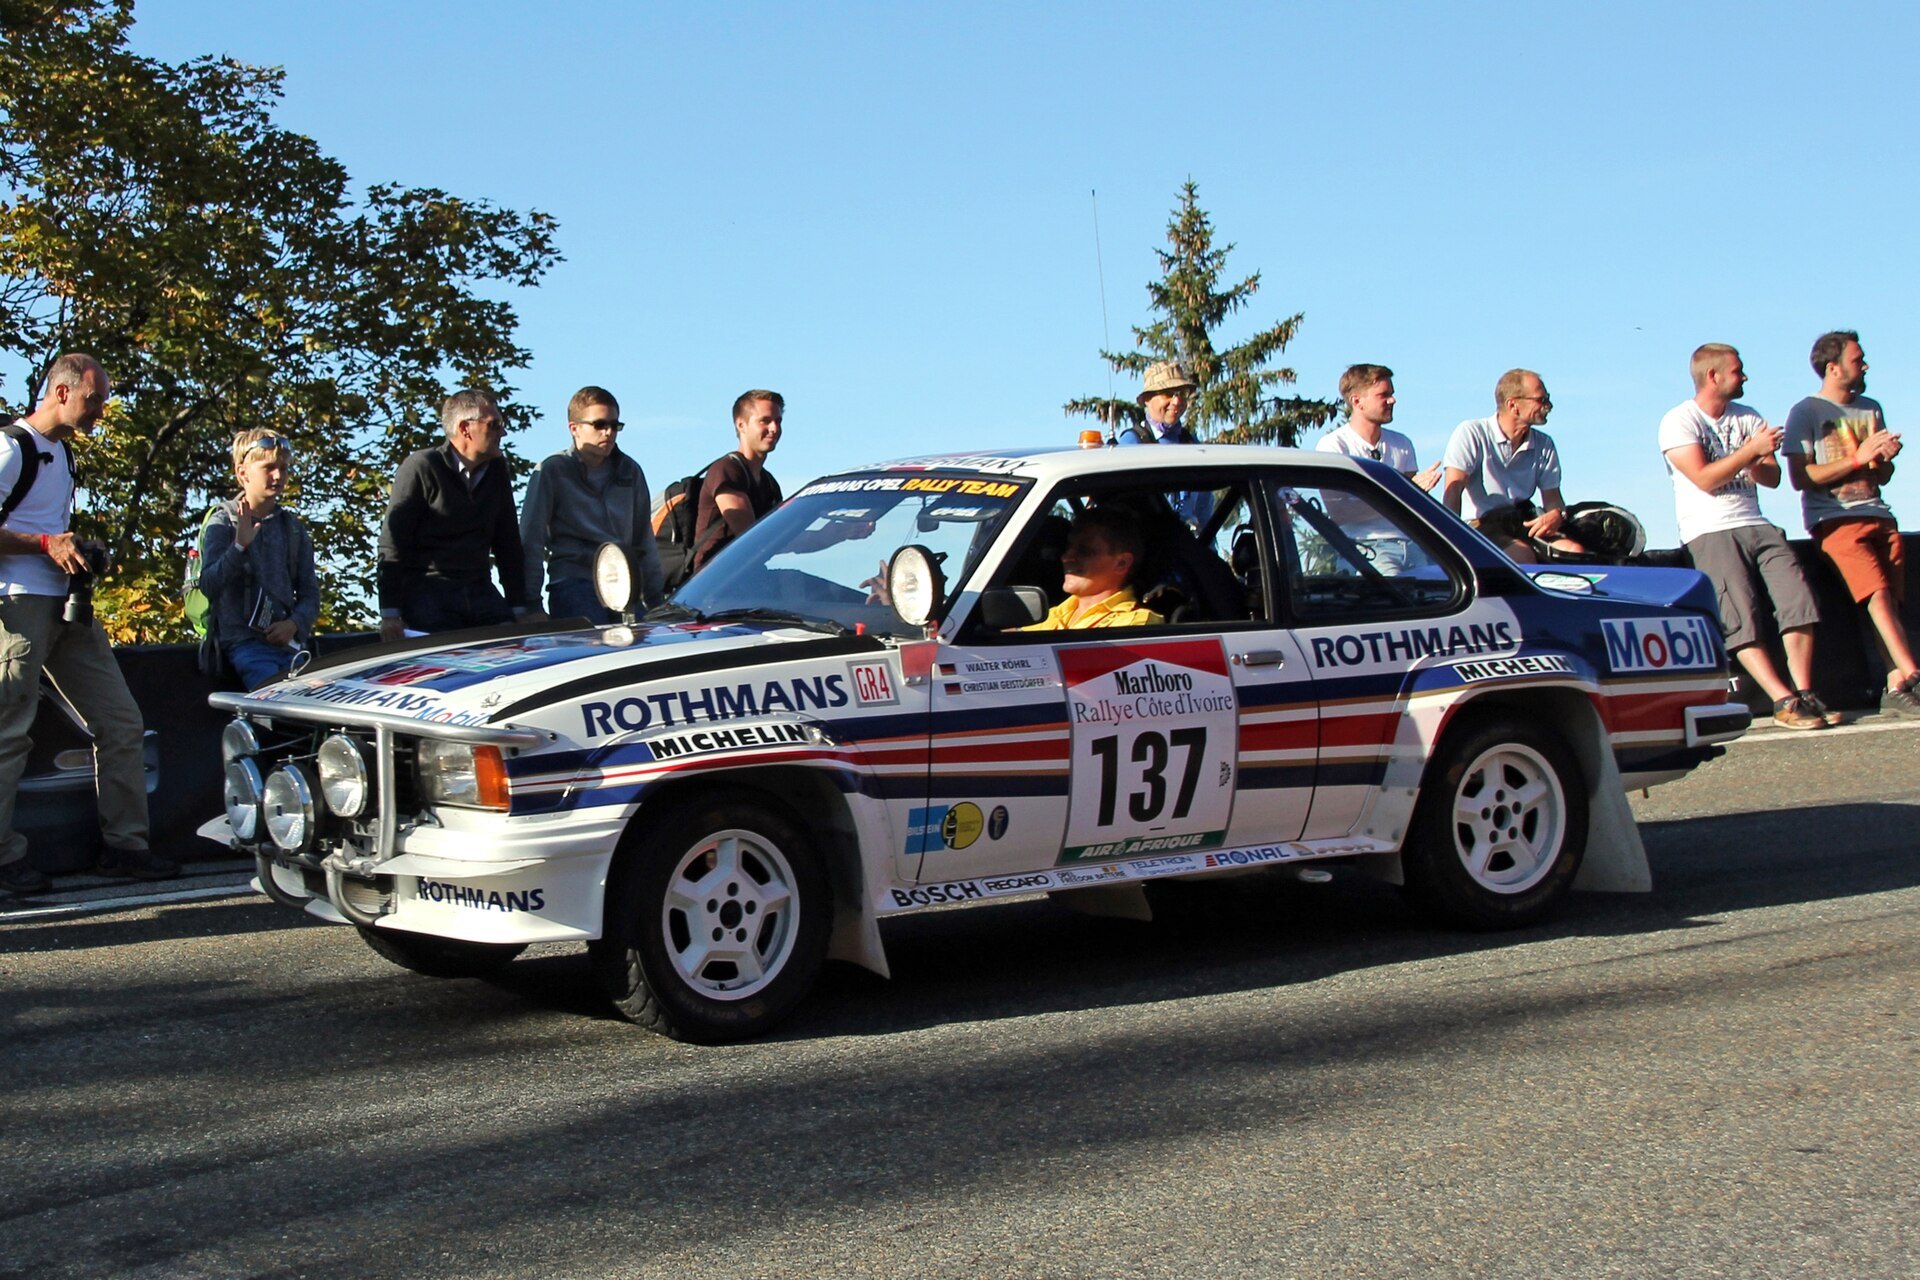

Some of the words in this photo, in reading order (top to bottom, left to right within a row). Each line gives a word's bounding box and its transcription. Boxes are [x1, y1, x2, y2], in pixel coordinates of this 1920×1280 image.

[863, 479, 904, 491] OPEL
[901, 478, 957, 492] RALLY
[957, 480, 1020, 498] TEAM
[1311, 621, 1516, 669] ROTHMANS
[1604, 618, 1714, 668] Mobil
[966, 661, 999, 672] WALTER
[1113, 664, 1192, 695] Marlboro
[1456, 655, 1574, 682] MICHELIN
[292, 682, 441, 711] ROTHMANS
[963, 681, 999, 692] CHRISTIAN
[1000, 678, 1044, 690] GEISTDÖRFER
[415, 705, 492, 728] Mobil
[581, 674, 849, 738] ROTHMANS
[1074, 699, 1132, 726] Rallye
[1135, 696, 1172, 719] Côte
[1174, 690, 1234, 715] d'Ivoire
[648, 724, 806, 760] MICHELIN
[1091, 726, 1207, 827] 137
[1079, 845, 1112, 858] AIR
[1126, 834, 1204, 853] AFRIQUE
[1215, 846, 1290, 866] RONAL
[1128, 855, 1193, 869] TELETRON
[417, 878, 545, 913] ROTHMANS
[891, 881, 983, 907] BOSCH
[985, 874, 1049, 892] RECARO
